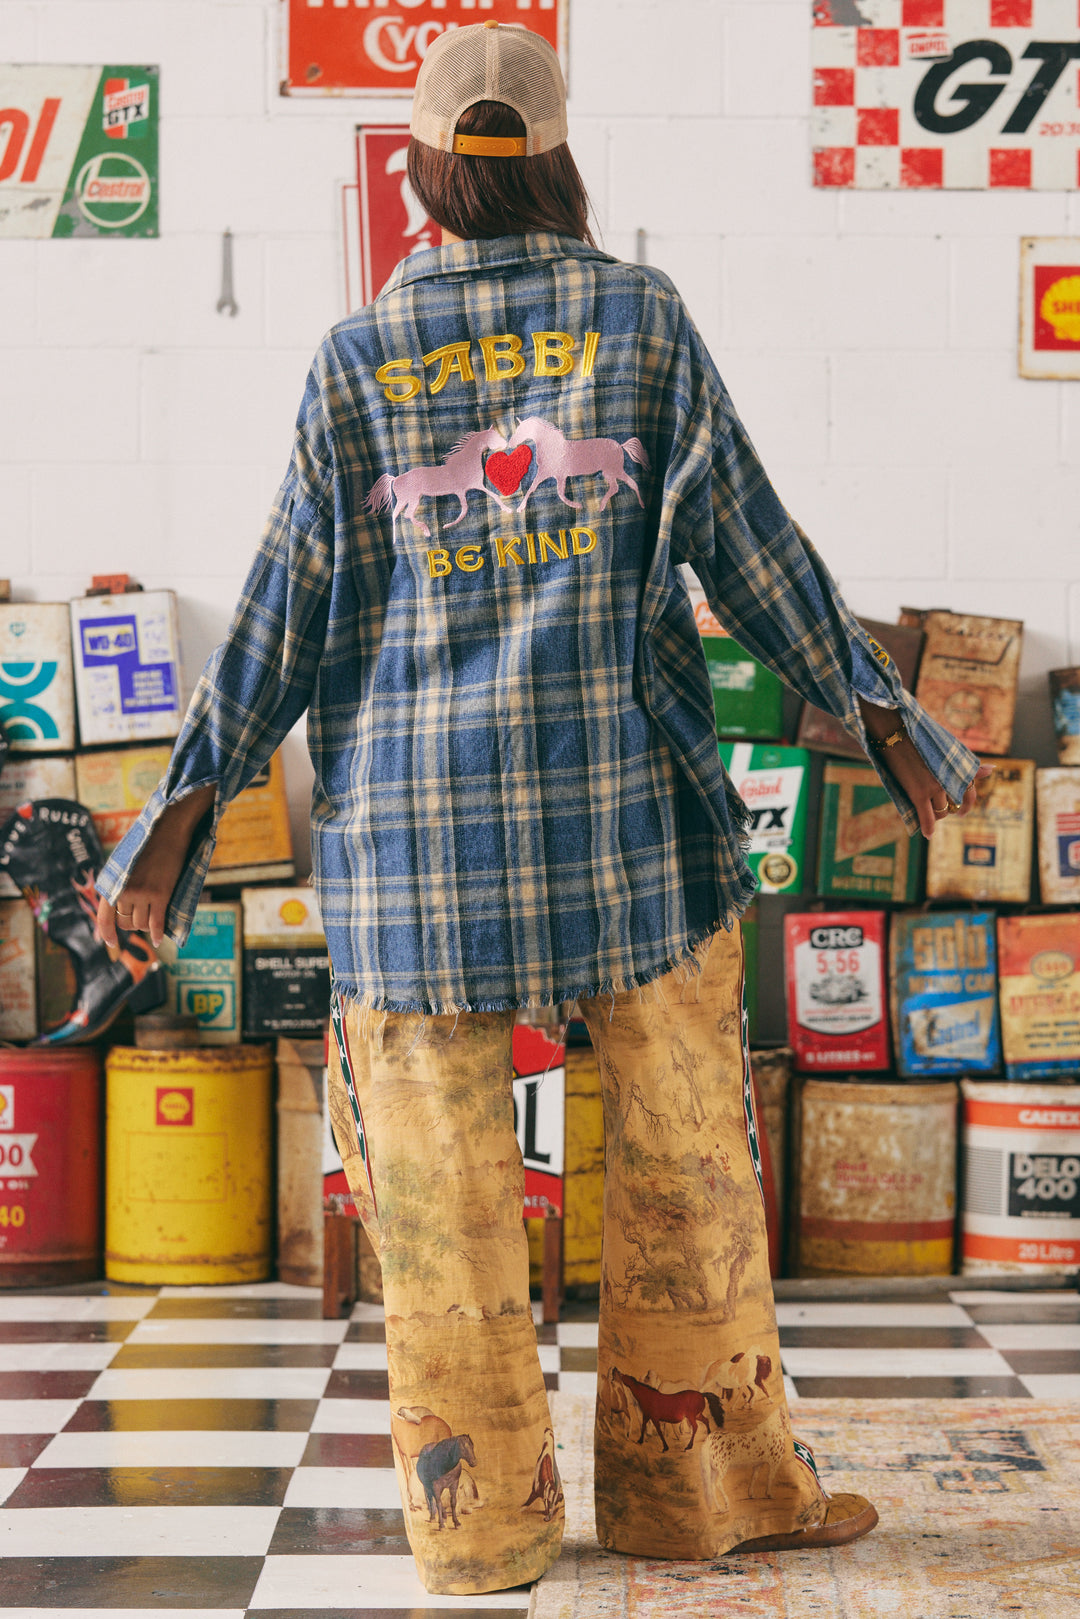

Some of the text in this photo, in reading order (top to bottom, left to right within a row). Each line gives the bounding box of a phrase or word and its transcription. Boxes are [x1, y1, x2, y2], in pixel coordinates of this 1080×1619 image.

[105, 104, 144, 127] GTX
[86, 180, 147, 199] Castrol
[375, 331, 601, 402] SABBI
[427, 527, 598, 578] BE KIND
[88, 632, 135, 651] WD-40
[811, 927, 863, 947] CRC
[255, 957, 292, 970] SHELL
[193, 993, 223, 1014] BP
[1019, 1110, 1080, 1126] CALTEX
[1013, 1157, 1080, 1180] DELO
[1017, 1179, 1077, 1201] 400
[1019, 1244, 1038, 1259] 20
